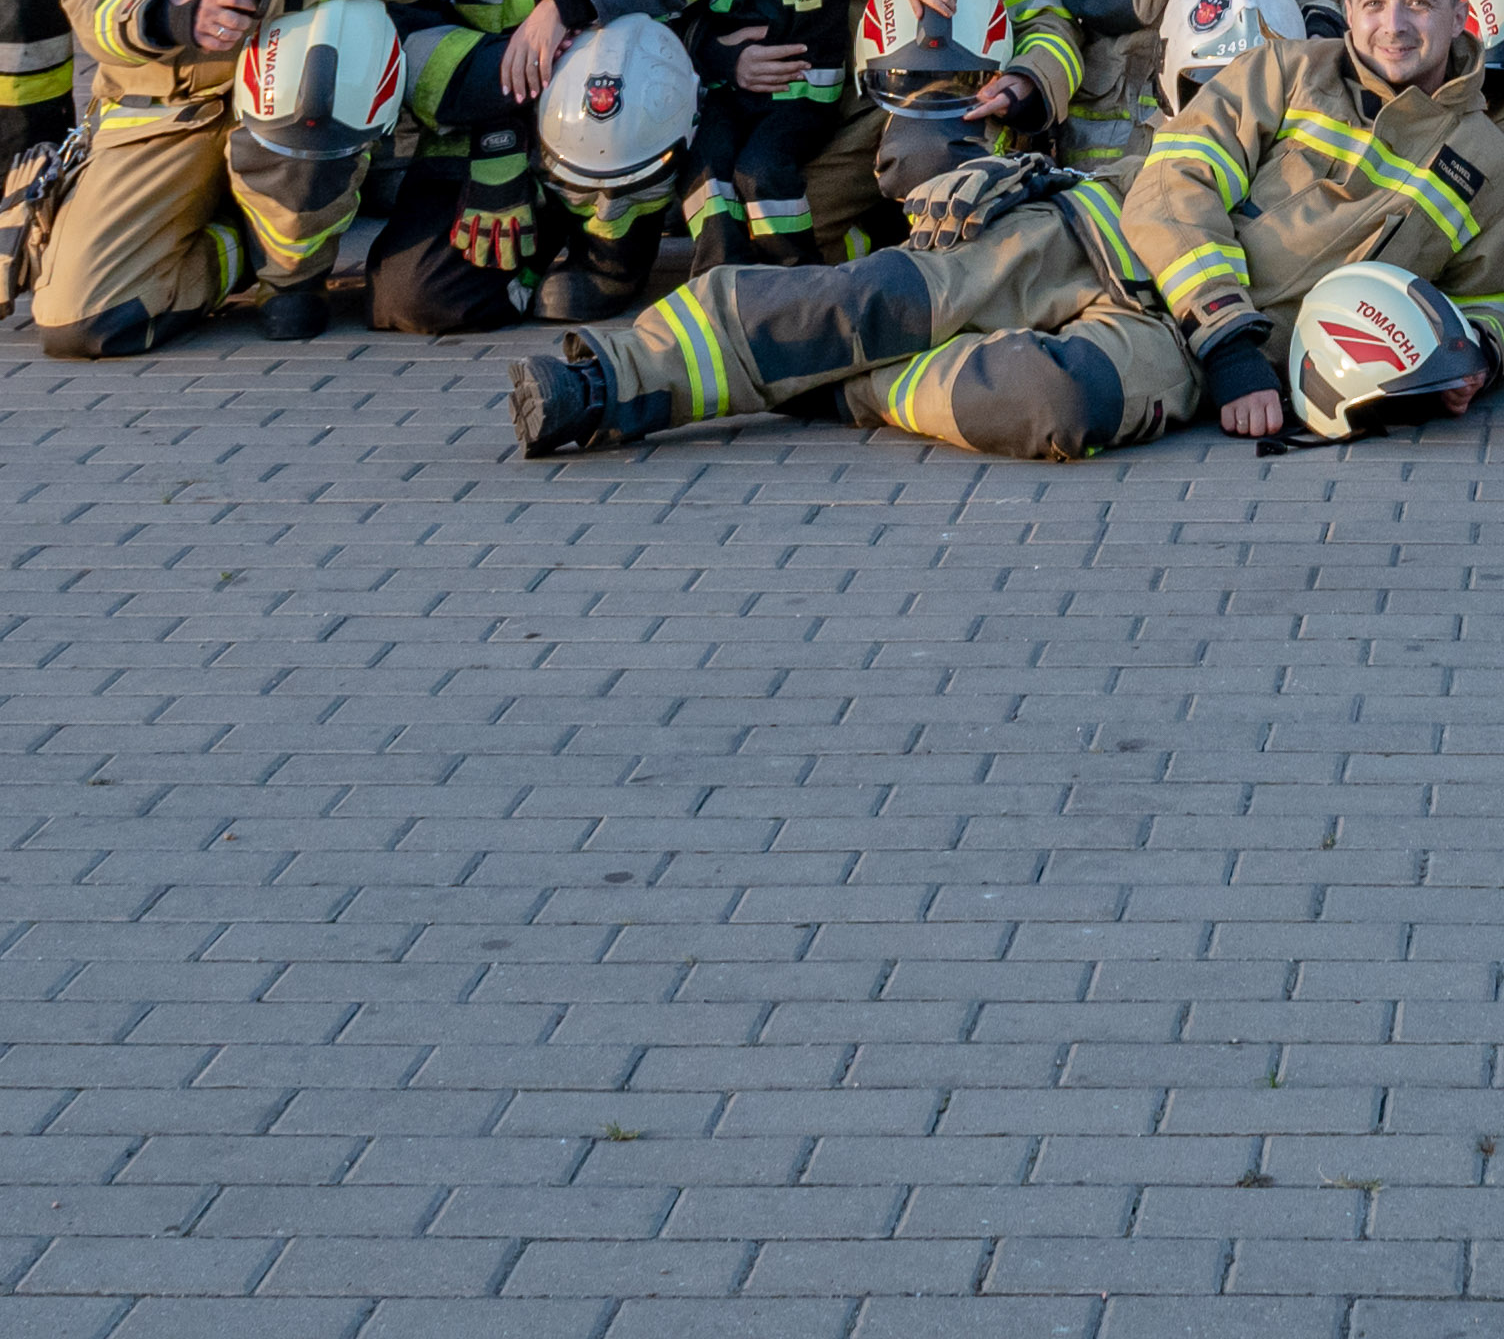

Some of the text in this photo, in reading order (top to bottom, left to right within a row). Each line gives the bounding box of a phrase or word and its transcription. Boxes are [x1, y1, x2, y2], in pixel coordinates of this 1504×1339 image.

[1216, 37, 1247, 56] 349
[262, 27, 281, 117] SZWAGIER
[595, 79, 615, 87] OSP
[1355, 300, 1422, 367] TOMACHA
